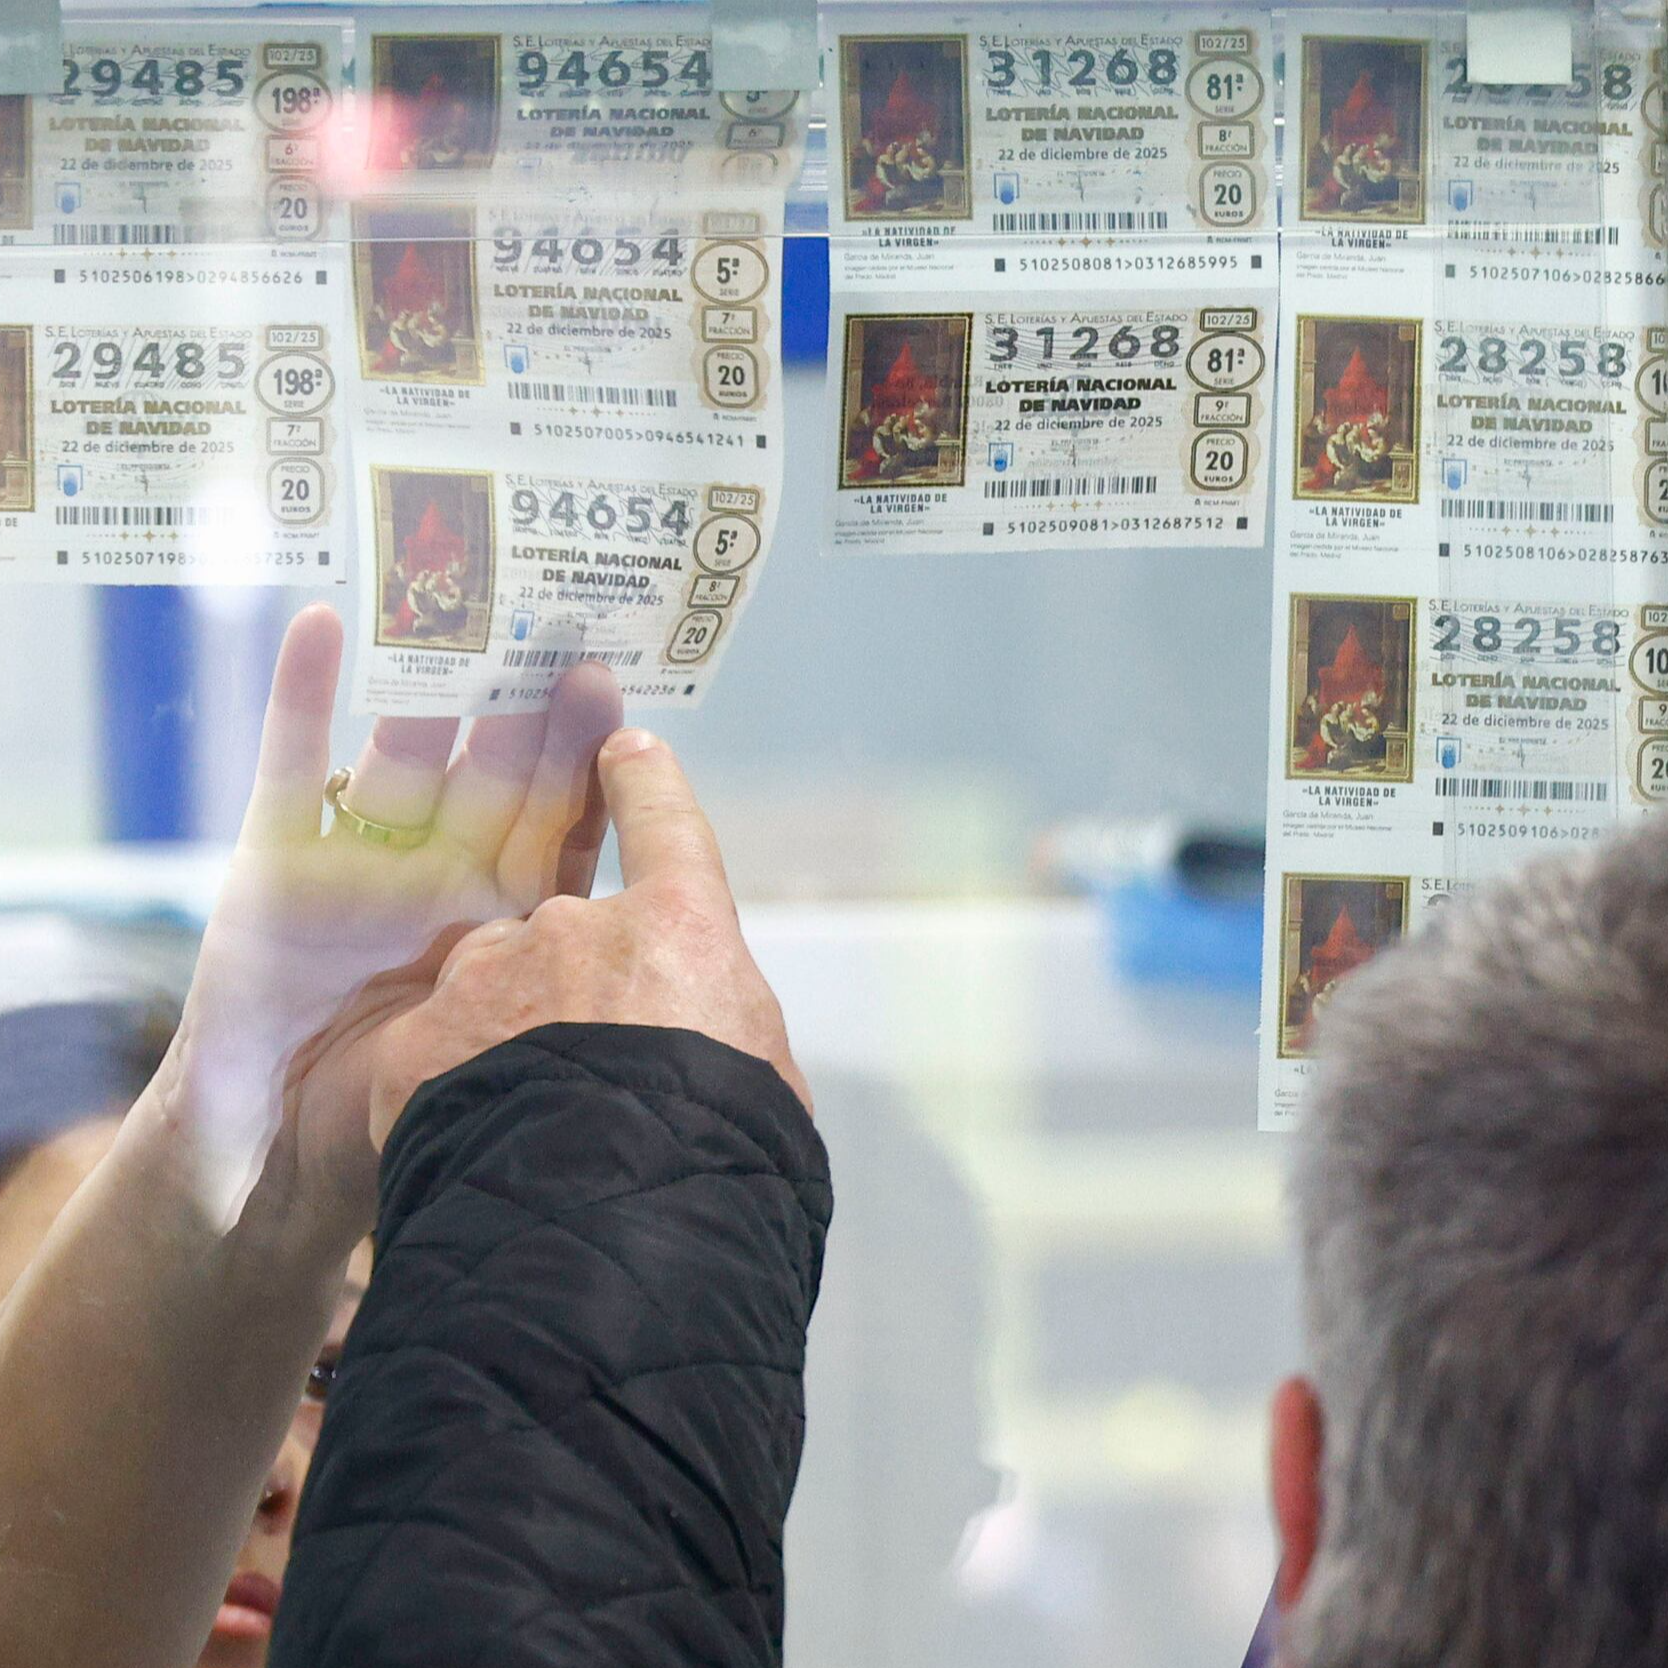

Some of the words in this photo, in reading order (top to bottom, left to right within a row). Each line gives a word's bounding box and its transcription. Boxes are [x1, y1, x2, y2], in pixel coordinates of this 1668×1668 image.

[1201, 36, 1246, 50] 102/25
[518, 50, 711, 89] 94654
[988, 49, 1178, 86] 31268
[1214, 184, 1242, 205] 20
[279, 197, 308, 219] 20
[492, 227, 683, 266] 94654
[493, 282, 575, 300] LOTERÍA
[583, 286, 683, 302] NACIONAL
[1207, 315, 1250, 325] 102/25
[989, 324, 1180, 362] 31268
[52, 342, 246, 379] 29485
[1439, 336, 1627, 378] 28258
[718, 365, 745, 387] 20
[985, 376, 1069, 393] LOTERÍA
[1077, 378, 1176, 391] NACIONAL
[51, 398, 136, 414] LOTERÍA
[144, 401, 246, 414] NACIONAL
[1019, 398, 1044, 412] DE
[1052, 398, 1141, 412] NAVIDAD
[1438, 392, 1519, 411] LOTERÍA
[1528, 397, 1627, 415] NACIONAL
[86, 422, 113, 435] DE
[120, 422, 211, 435] NAVIDAD
[994, 420, 1010, 430] 22
[1015, 418, 1032, 430] de
[1037, 417, 1105, 429] diciembre
[1109, 417, 1126, 428] de
[1130, 417, 1163, 427] 2025
[1206, 451, 1234, 471] 20
[281, 479, 309, 501] 20
[714, 490, 754, 507] 102/25
[512, 489, 689, 536] 94654
[512, 546, 589, 565] LOTERÍA
[595, 552, 683, 571] NACIONAL
[543, 569, 565, 584] DE
[572, 571, 650, 589] NAVIDAD
[682, 627, 707, 645] 20
[1433, 615, 1619, 656] 28258
[1432, 671, 1514, 689] LOTERÍA
[1522, 676, 1620, 692] NACIONAL
[1466, 694, 1492, 708] DE
[1498, 696, 1587, 712] NAVIDAD
[1442, 714, 1458, 726] 22
[1463, 714, 1480, 726] de
[1484, 714, 1551, 728] diciembre
[1555, 717, 1572, 728] de
[1576, 717, 1609, 730] 2025
